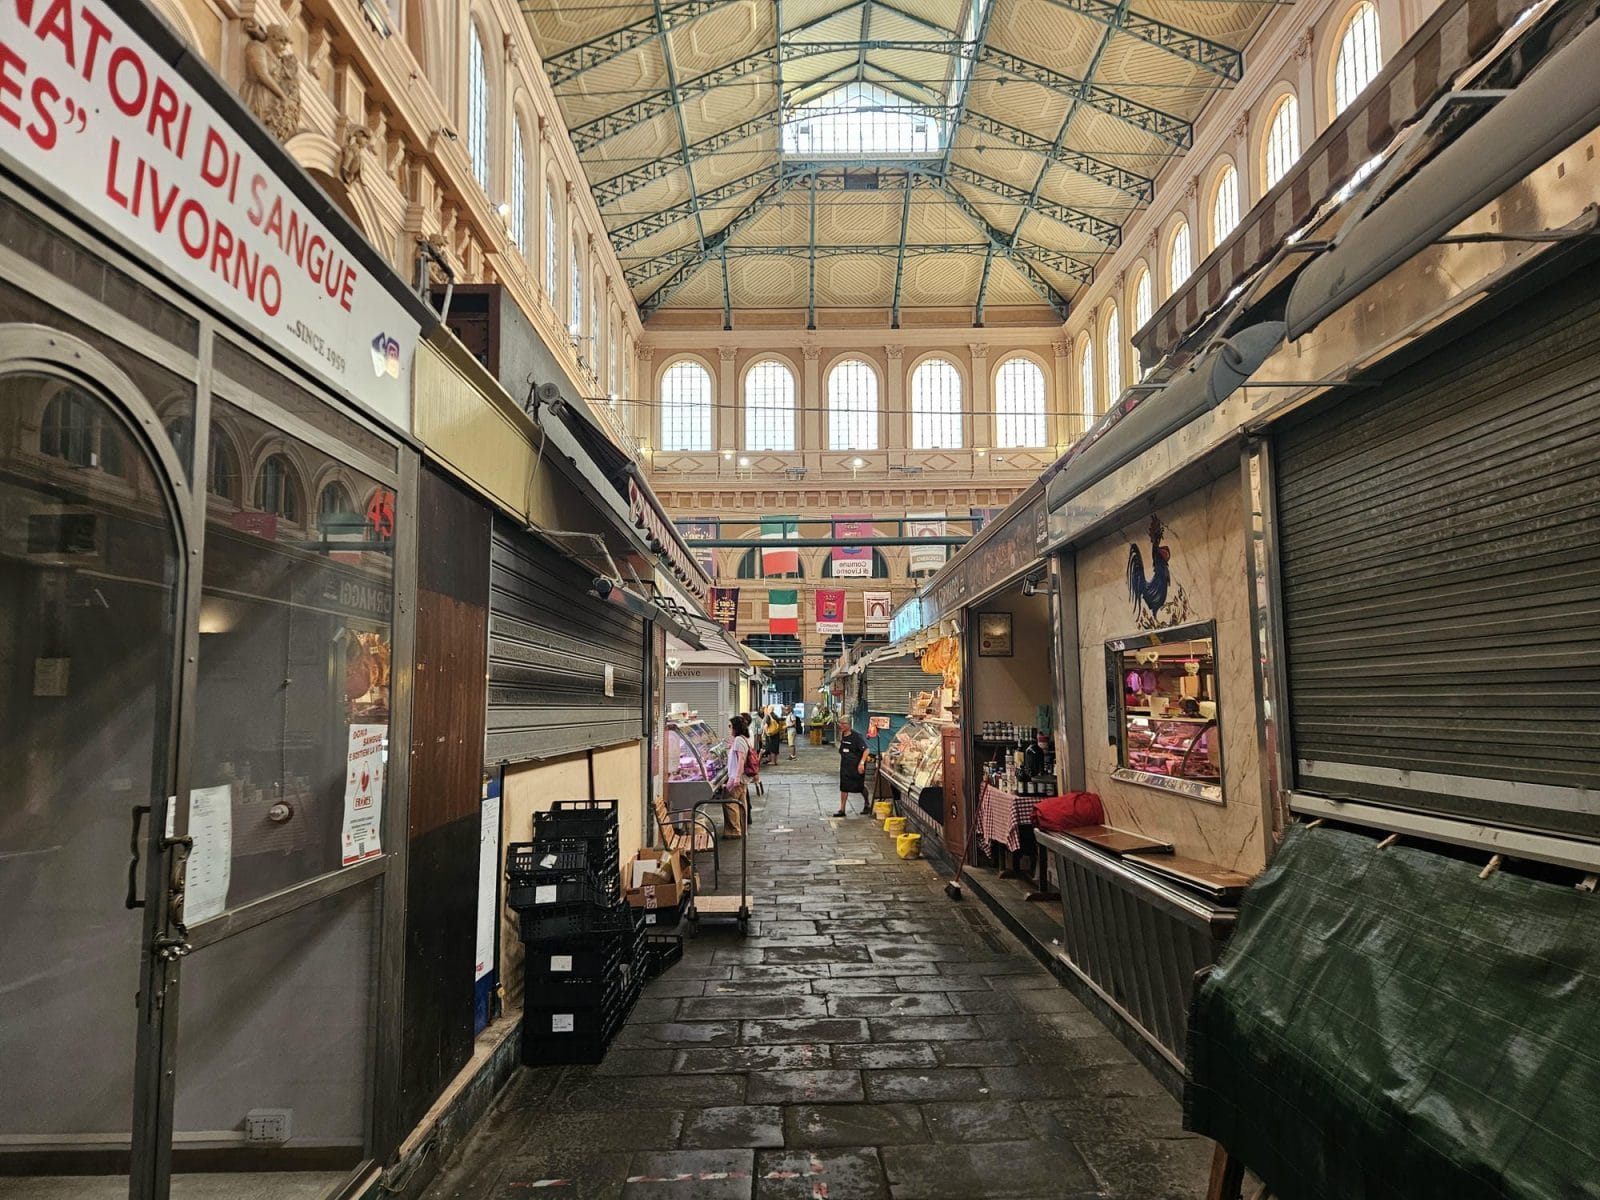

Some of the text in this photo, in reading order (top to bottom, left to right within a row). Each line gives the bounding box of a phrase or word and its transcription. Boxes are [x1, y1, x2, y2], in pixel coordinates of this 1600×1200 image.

[106, 136, 282, 317] LIVORNO
[200, 125, 241, 205] DI
[246, 173, 358, 313] SANGUE
[326, 347, 346, 374] 1959
